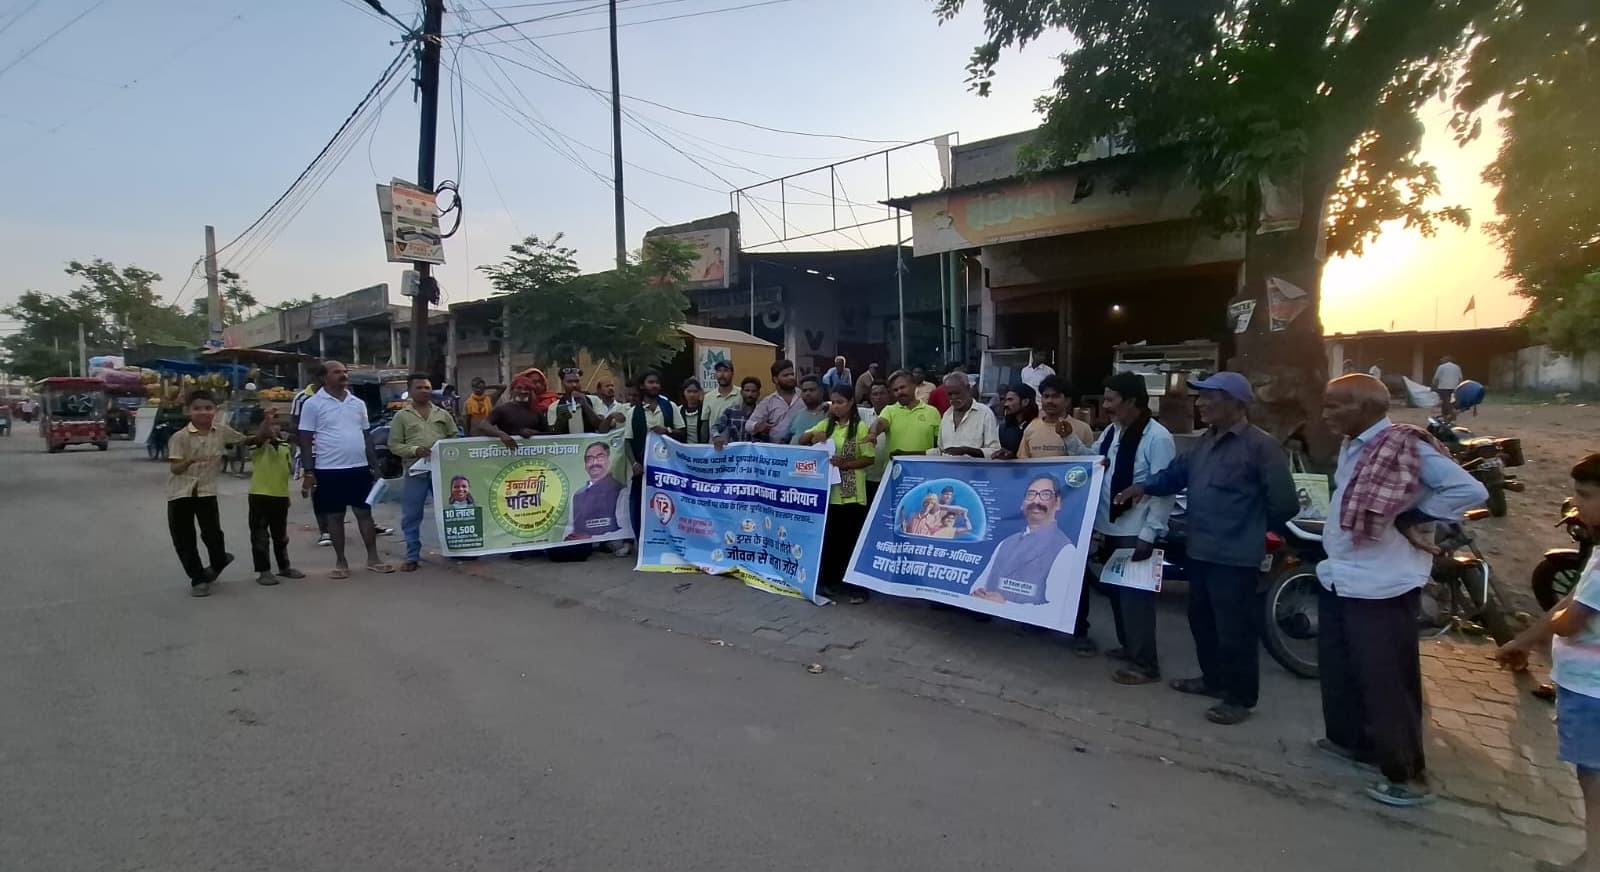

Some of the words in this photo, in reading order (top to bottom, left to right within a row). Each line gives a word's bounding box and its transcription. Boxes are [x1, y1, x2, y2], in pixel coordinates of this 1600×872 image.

[548, 442, 580, 456] योजना
[505, 490, 541, 511] पहिया
[780, 487, 819, 507] अभियान
[445, 510, 455, 518] 10
[446, 525, 475, 536] ₹4,500
[726, 545, 756, 563] जीवन
[757, 548, 769, 565] से
[928, 562, 973, 585] सरकार
